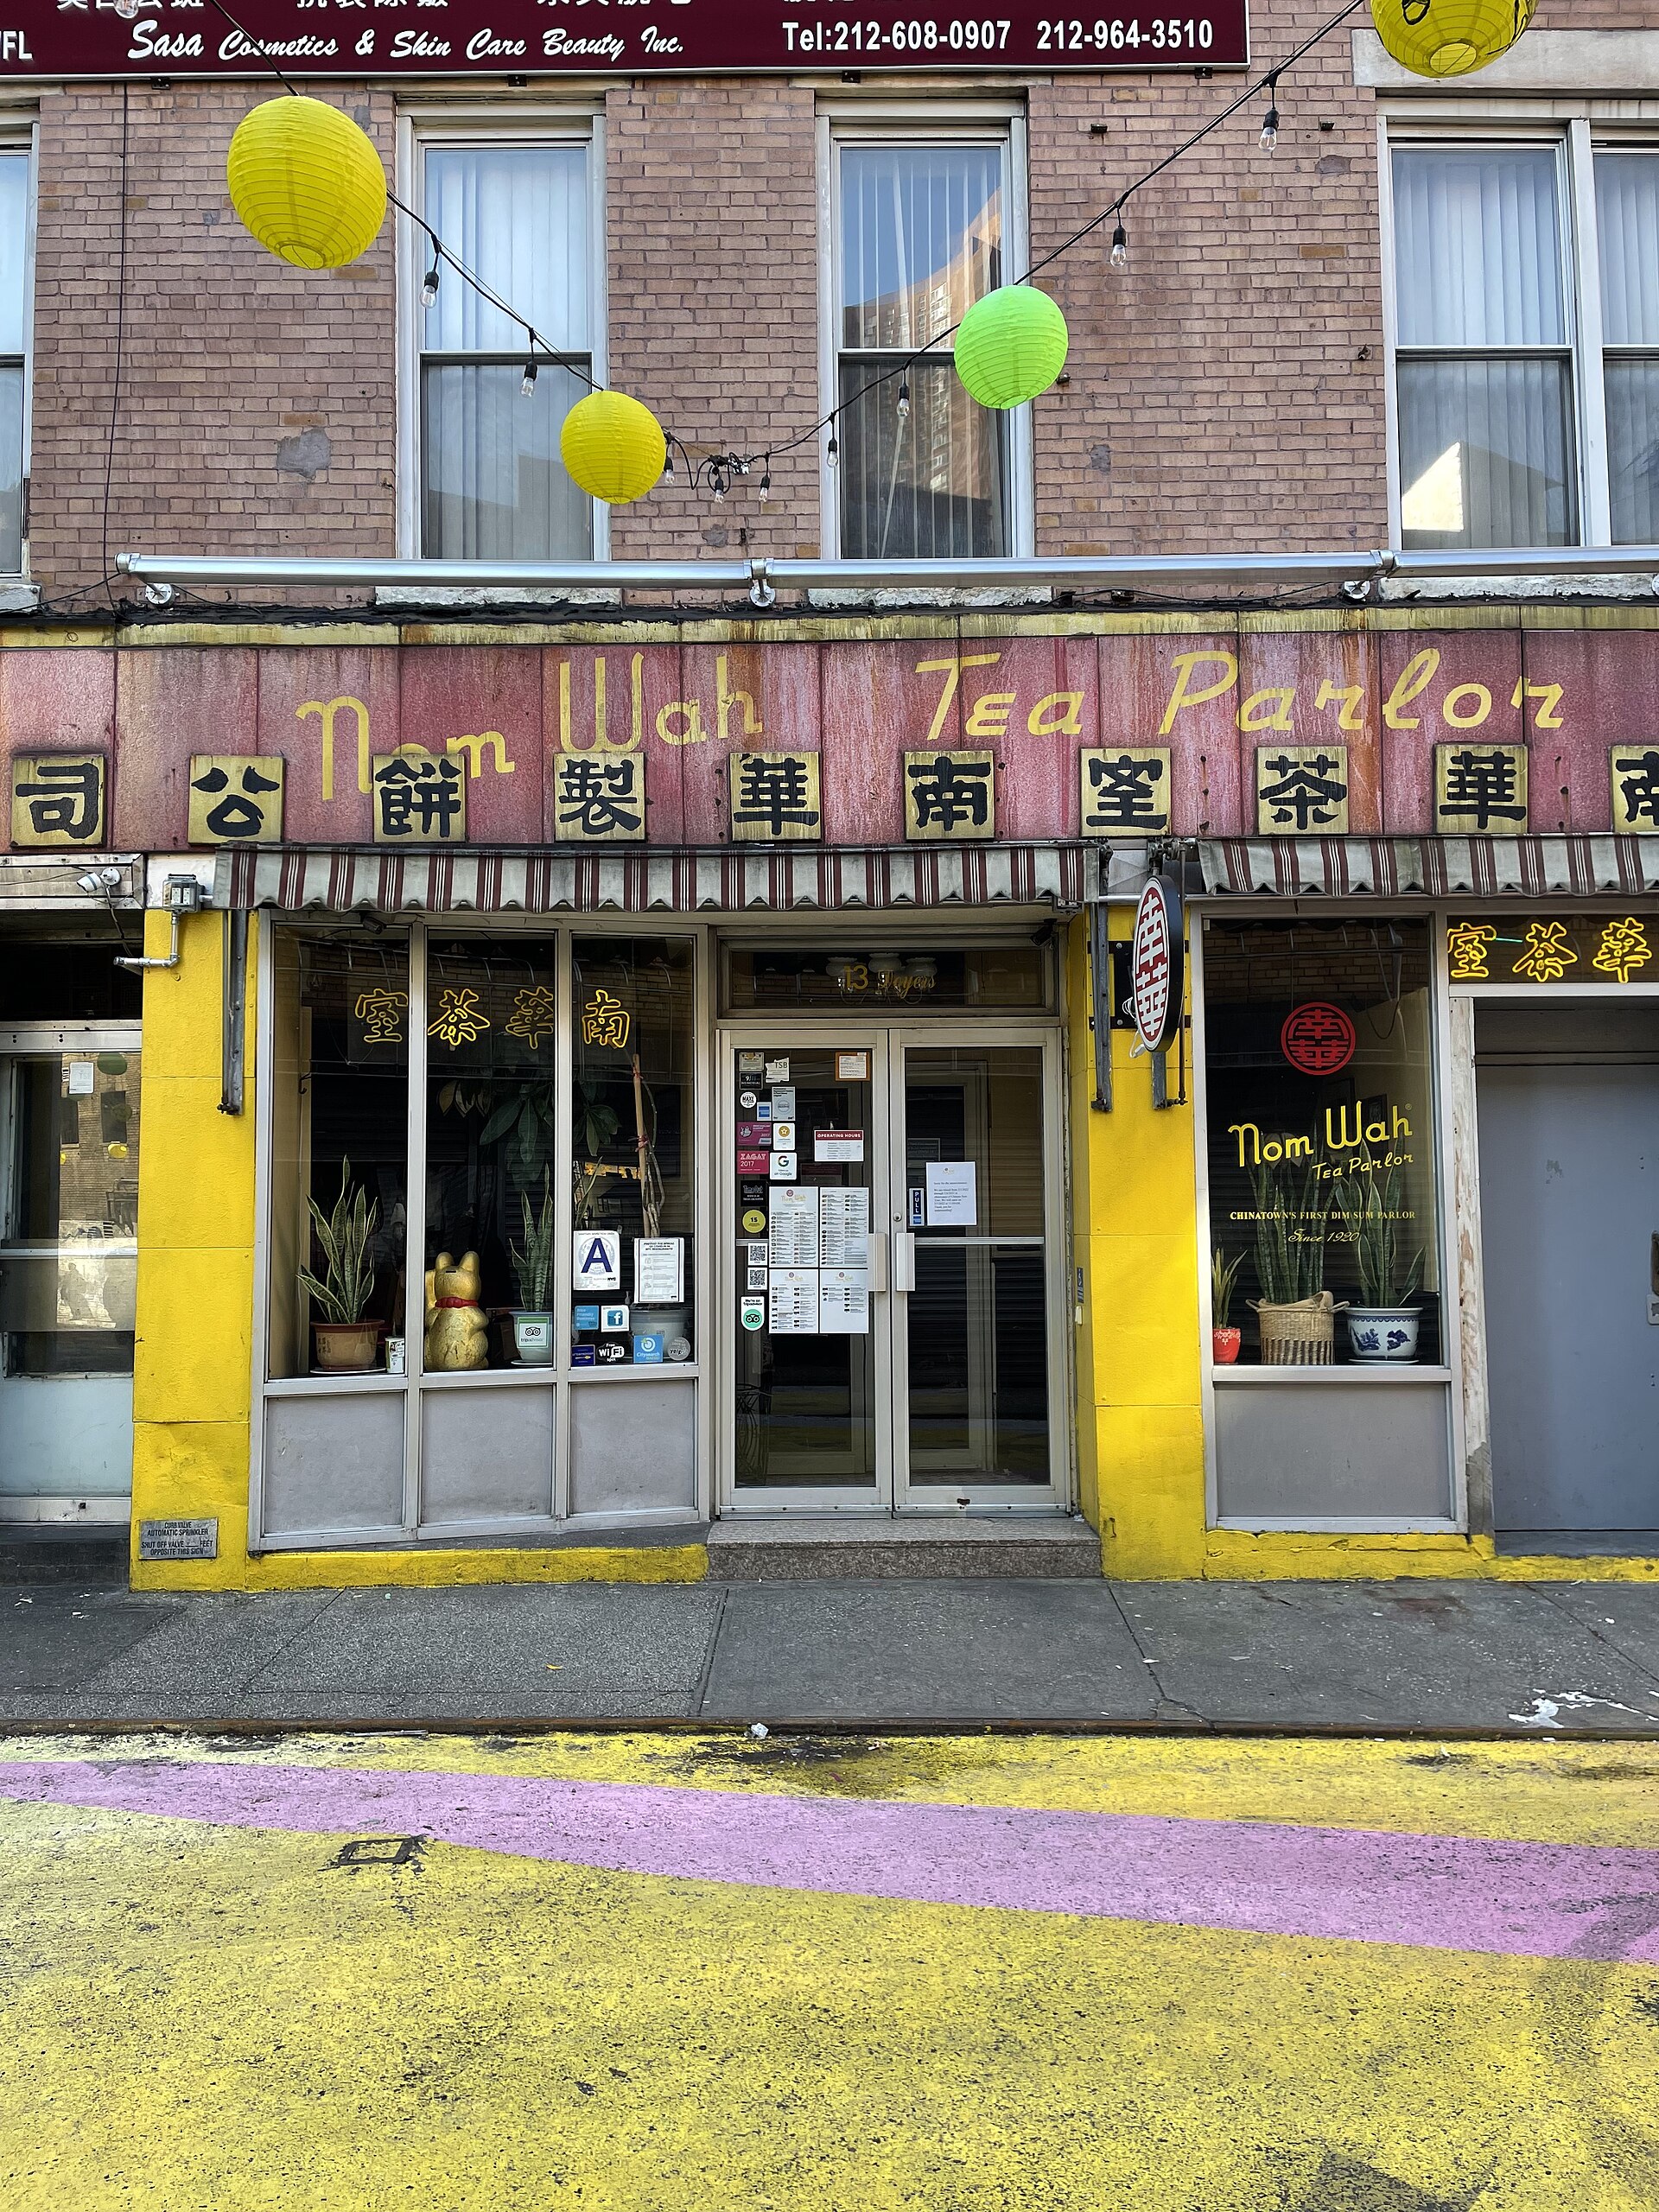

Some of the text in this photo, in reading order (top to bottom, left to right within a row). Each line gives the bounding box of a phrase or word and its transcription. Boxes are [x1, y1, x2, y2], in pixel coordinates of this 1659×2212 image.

[128, 19, 683, 61] Sasa Cosmetics & Skin Care Beauty Inc.
[783, 20, 1213, 50] Tel:212-608-0907 212-964-3510
[295, 647, 1564, 802] Nm Wah Tea Parlor
[843, 964, 869, 990] 13
[1228, 1100, 1414, 1168] Nom Wah
[1312, 1153, 1414, 1181] Tea Parlor
[1230, 1211, 1416, 1220] CHINATOWN'S FIRST DIM SUM PARLOR
[1287, 1228, 1360, 1243] Since 1920
[581, 1237, 613, 1274] A
